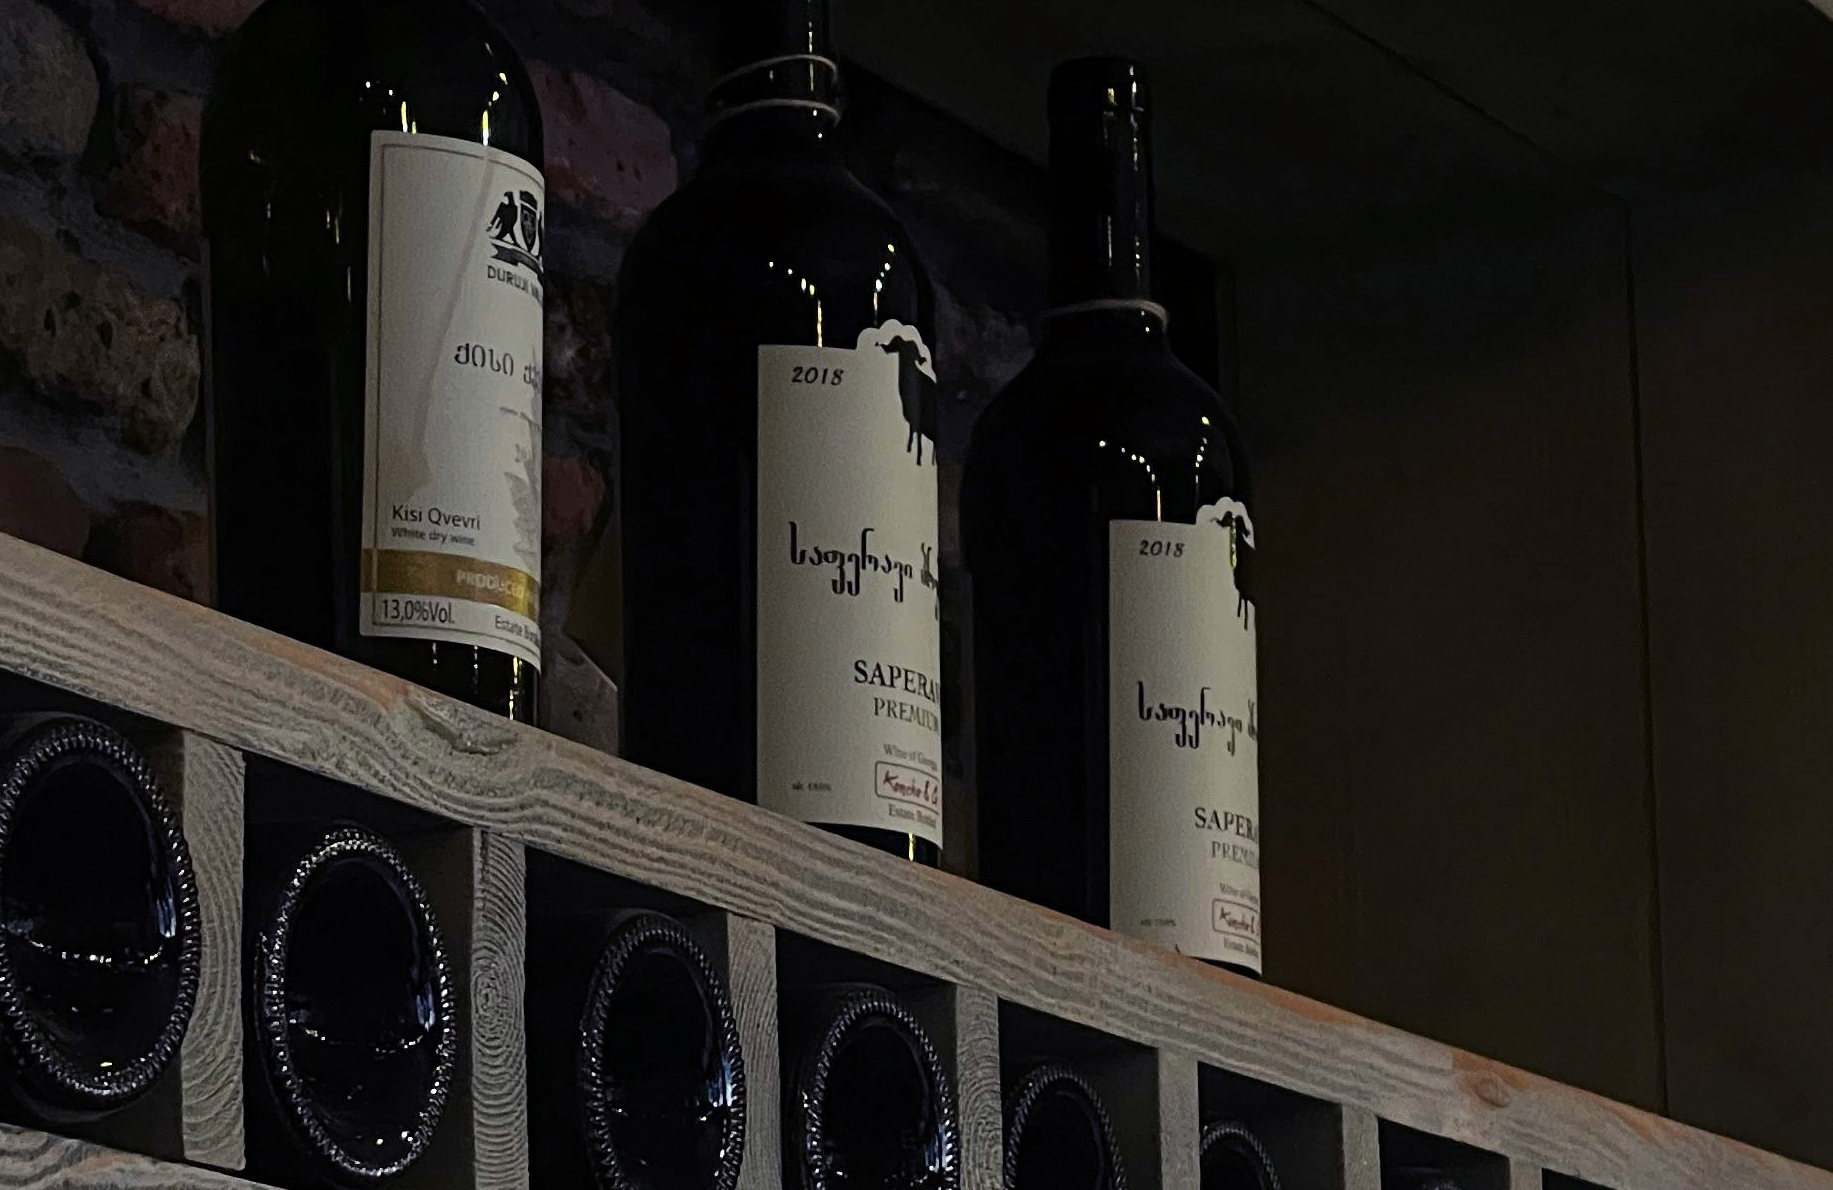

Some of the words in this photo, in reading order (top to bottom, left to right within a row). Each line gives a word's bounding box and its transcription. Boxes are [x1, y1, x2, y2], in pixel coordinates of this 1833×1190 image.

[792, 366, 844, 386] 2018
[392, 505, 422, 523] Kisi
[428, 507, 480, 530] Qvevri
[391, 527, 425, 541] White
[429, 530, 447, 545] dry
[451, 534, 475, 546] wine
[1140, 540, 1184, 557] 2018
